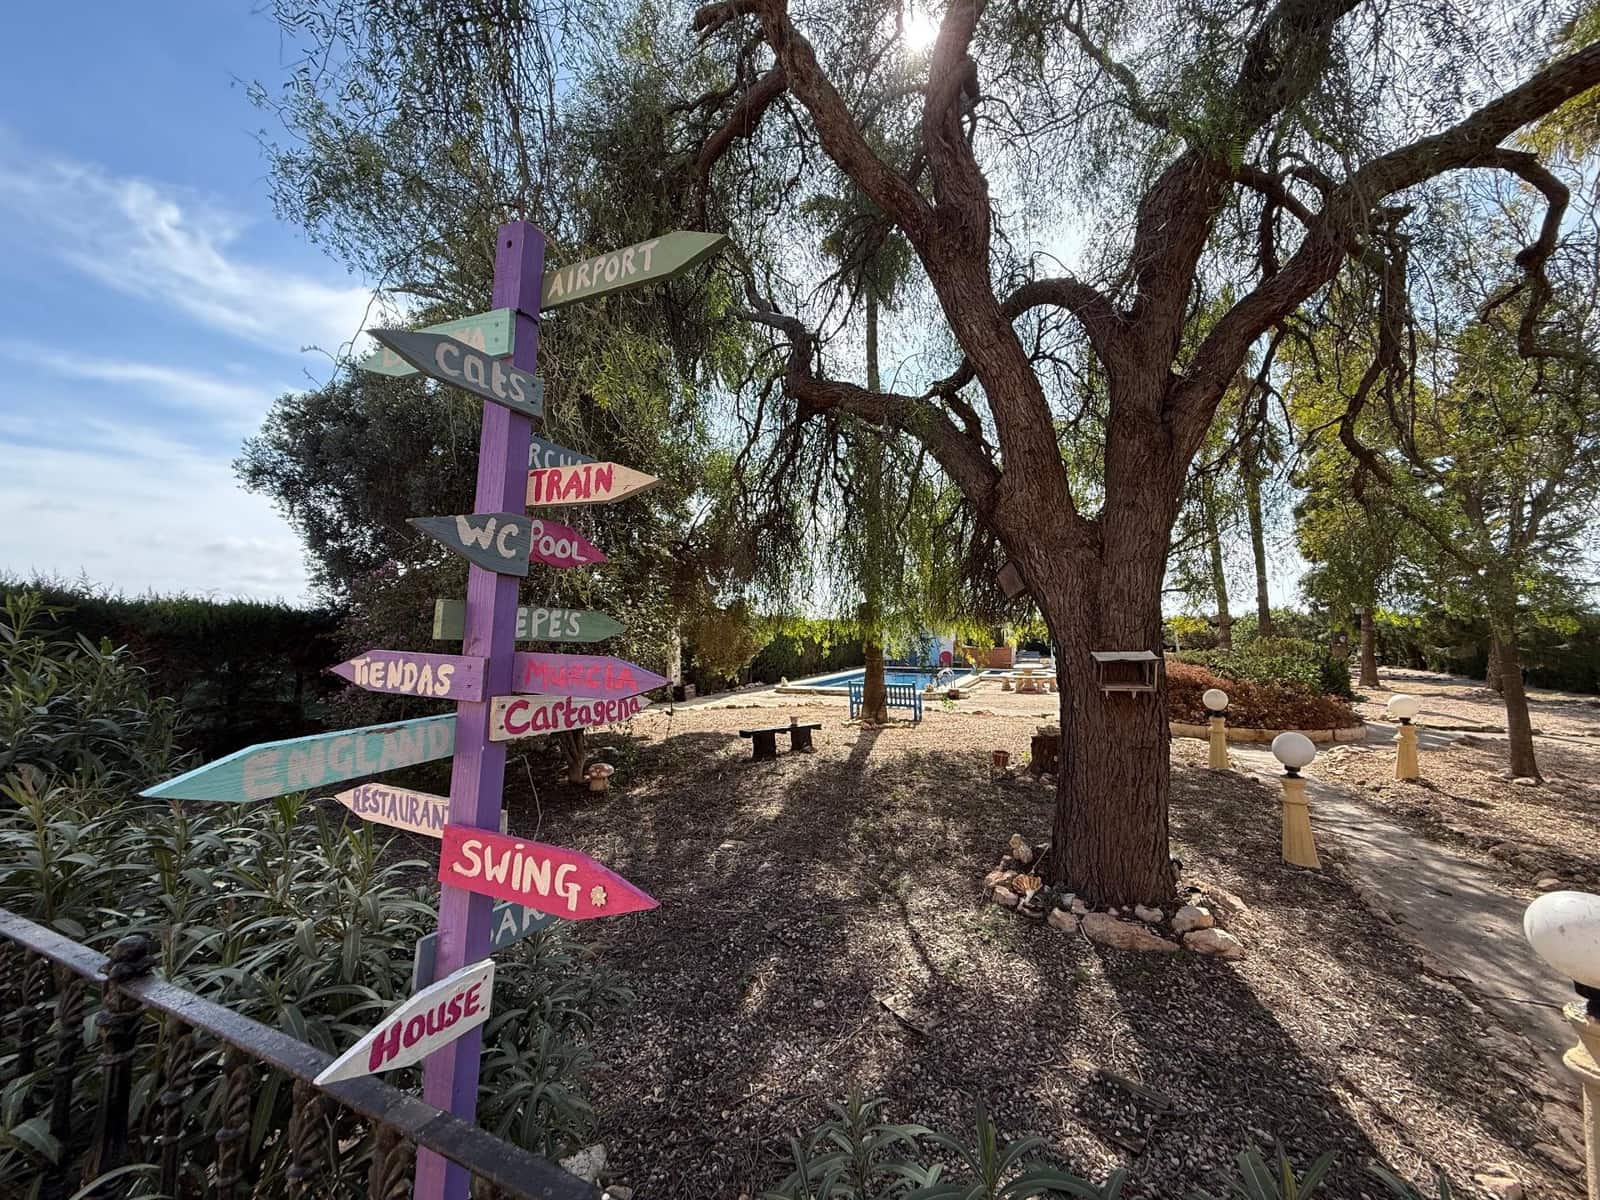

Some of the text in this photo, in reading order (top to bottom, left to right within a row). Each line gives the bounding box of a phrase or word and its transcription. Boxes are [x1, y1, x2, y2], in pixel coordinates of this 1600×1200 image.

[547, 240, 659, 298] AIRPORT
[435, 342, 525, 401] Cats
[529, 463, 613, 502] TRAIN
[456, 515, 519, 558] WC
[530, 519, 588, 561] POOL
[516, 607, 581, 638] EPE'S
[504, 697, 641, 735] Cartagena
[243, 723, 449, 798] ENGLAND
[352, 786, 449, 829] RESTAURAN
[368, 981, 482, 1072] HOUSE
